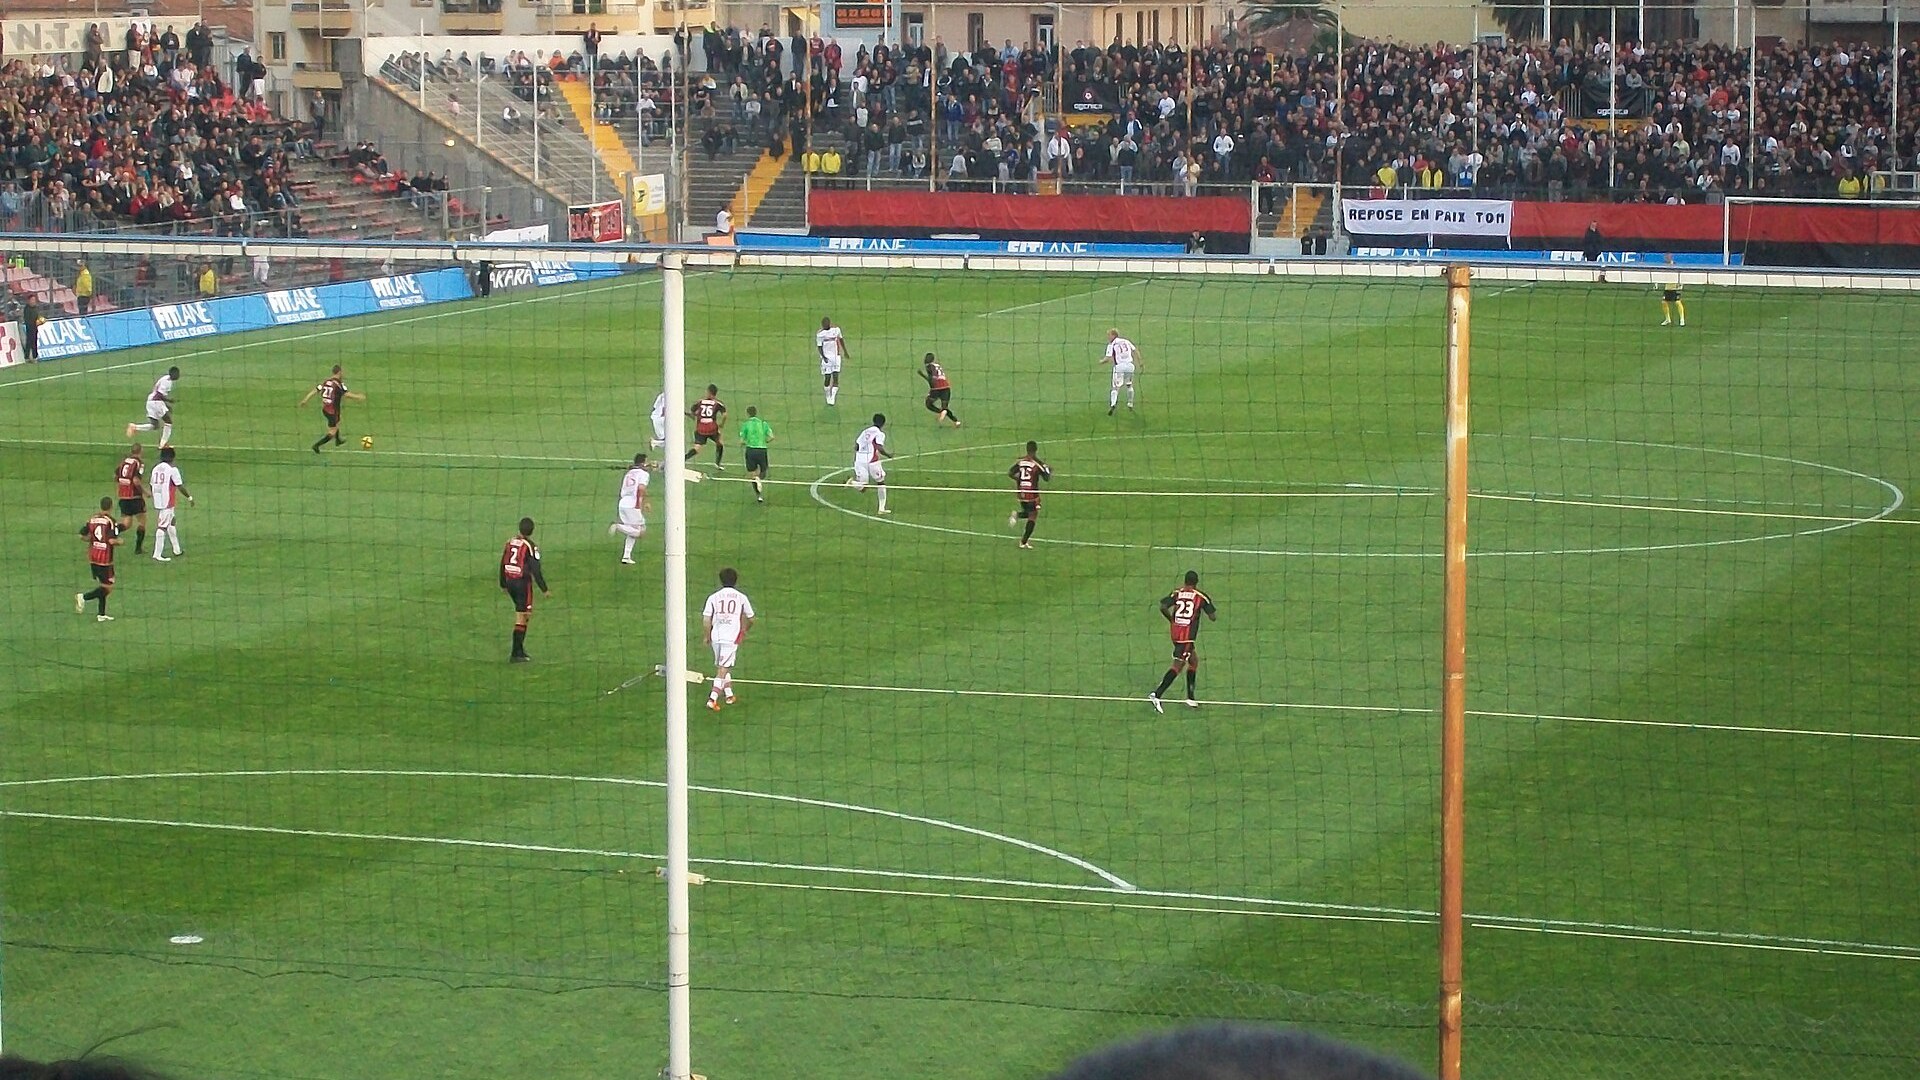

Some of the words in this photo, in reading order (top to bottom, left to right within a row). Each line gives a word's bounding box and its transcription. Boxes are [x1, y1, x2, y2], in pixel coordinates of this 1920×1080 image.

[1349, 209, 1403, 220] REPOSE
[1411, 210, 1430, 220] EN
[1435, 210, 1465, 223] PAIX
[1476, 212, 1505, 224] TOM
[700, 405, 713, 417] 26
[154, 472, 165, 484] 19
[94, 525, 102, 541] 4
[510, 547, 518, 564] 2
[718, 599, 736, 614] 10
[1175, 600, 1194, 618] 23
